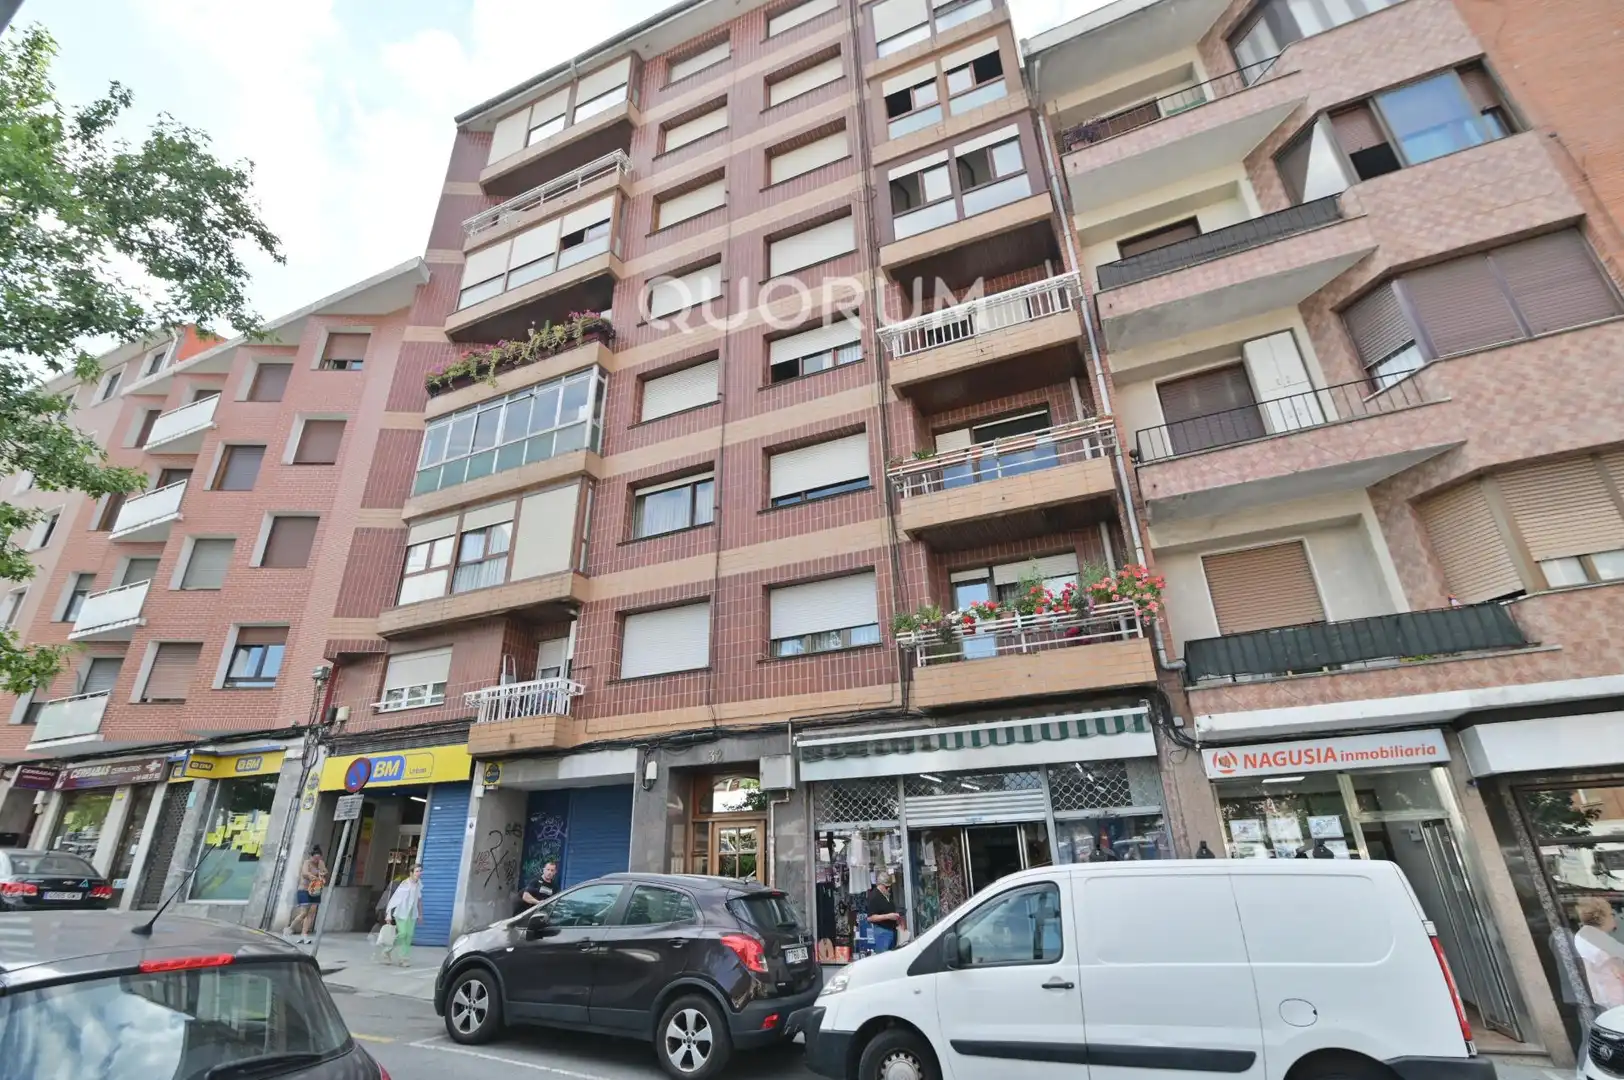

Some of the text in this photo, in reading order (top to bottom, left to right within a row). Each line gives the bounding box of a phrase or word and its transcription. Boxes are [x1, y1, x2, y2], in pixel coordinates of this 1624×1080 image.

[1243, 743, 1437, 769] NAGUSIA inmobiliaria
[373, 759, 400, 778] BM
